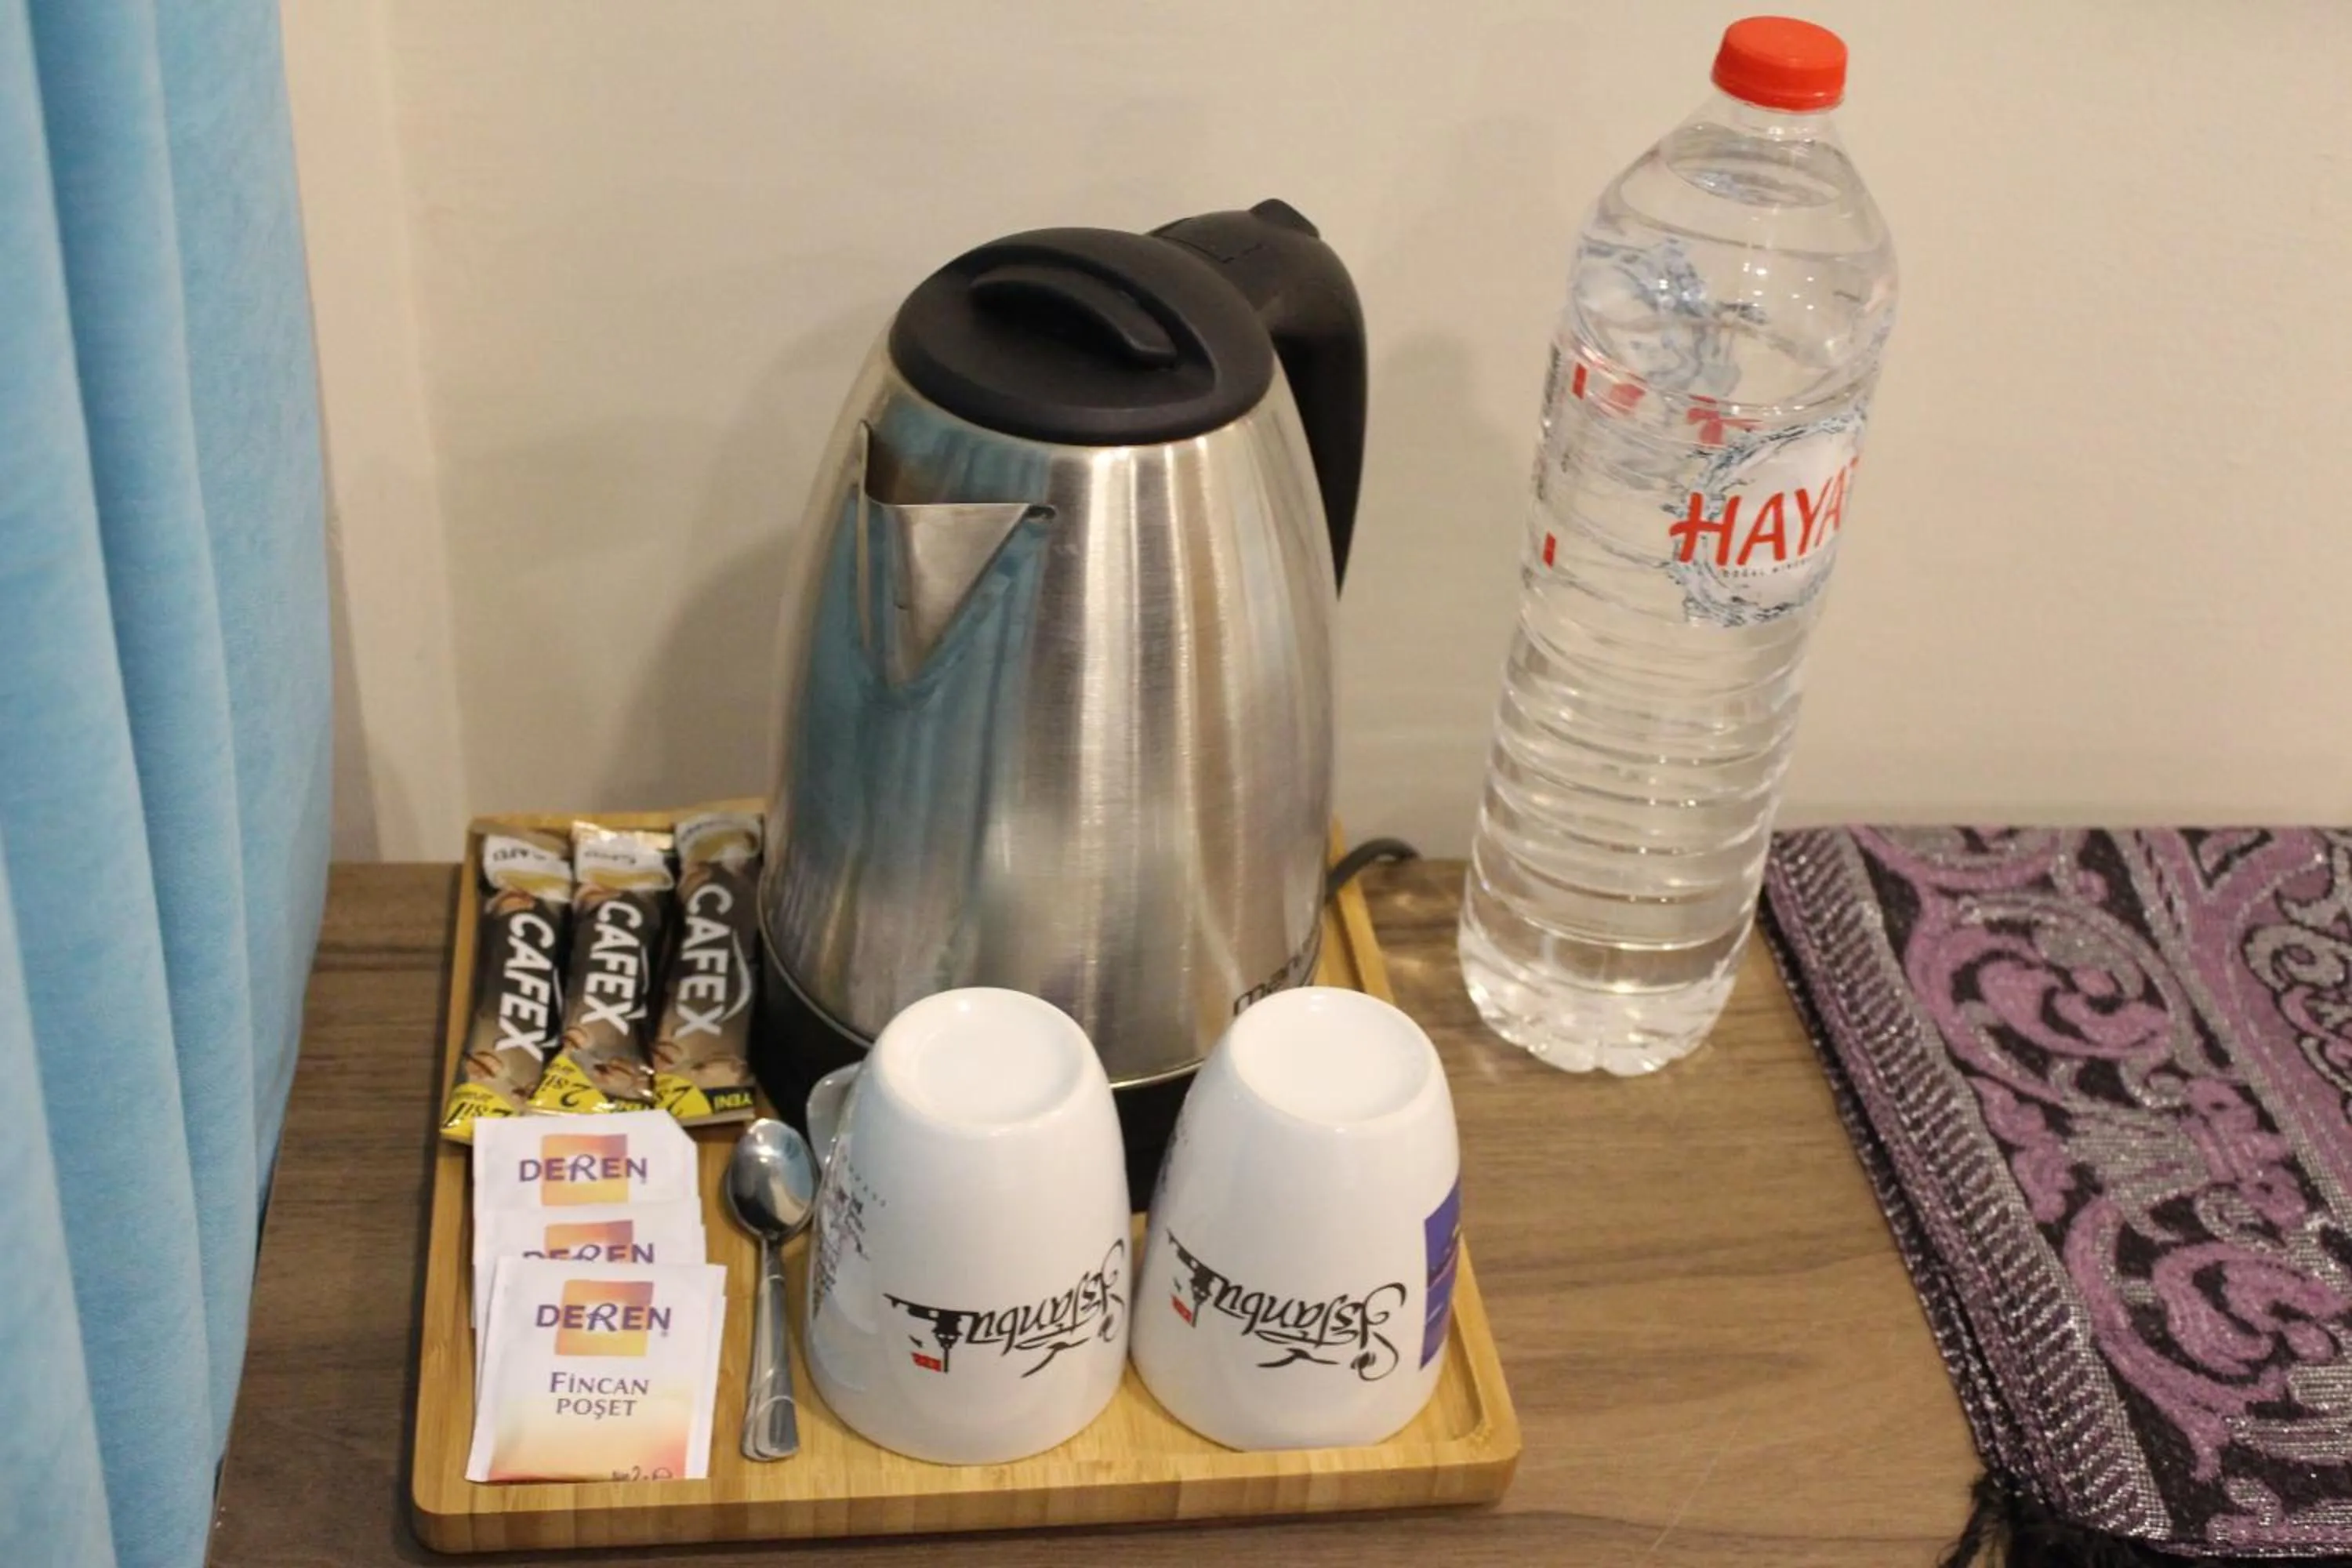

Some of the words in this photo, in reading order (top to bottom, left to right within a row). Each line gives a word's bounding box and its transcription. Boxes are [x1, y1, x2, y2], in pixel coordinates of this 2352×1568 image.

[1668, 456, 1859, 567] HAYA
[495, 912, 555, 1062] CAFEX
[580, 901, 643, 1036] CAFEX
[674, 884, 733, 1038] CAFEX
[518, 1153, 648, 1183] DEREN
[535, 1302, 671, 1332] DEREN
[556, 1399, 637, 1420] POŞET
